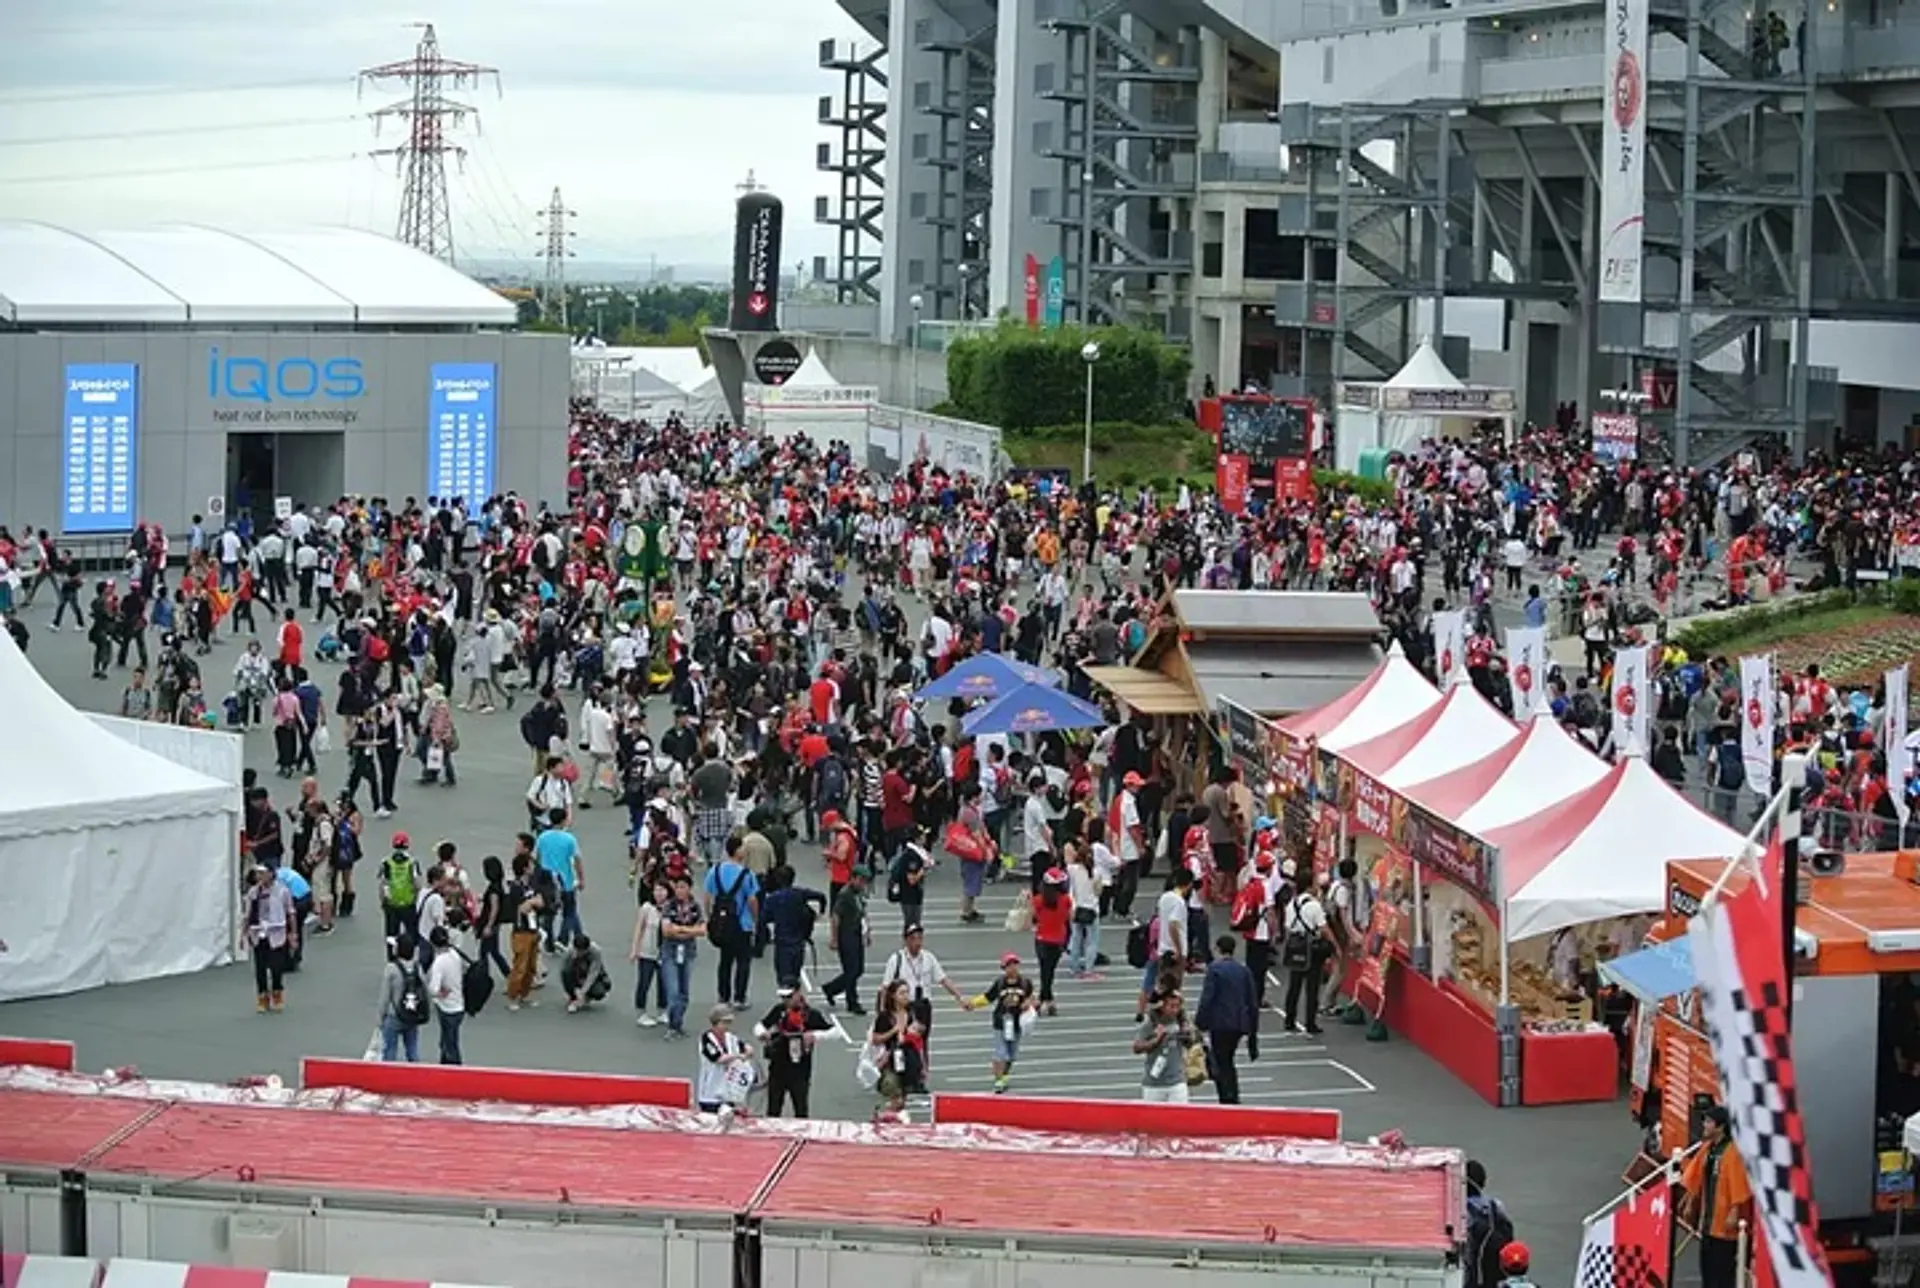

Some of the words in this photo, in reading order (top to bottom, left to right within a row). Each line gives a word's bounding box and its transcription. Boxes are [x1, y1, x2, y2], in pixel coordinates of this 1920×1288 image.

[209, 346, 365, 403] iQOS
[213, 409, 239, 421] heat
[242, 410, 262, 421] not
